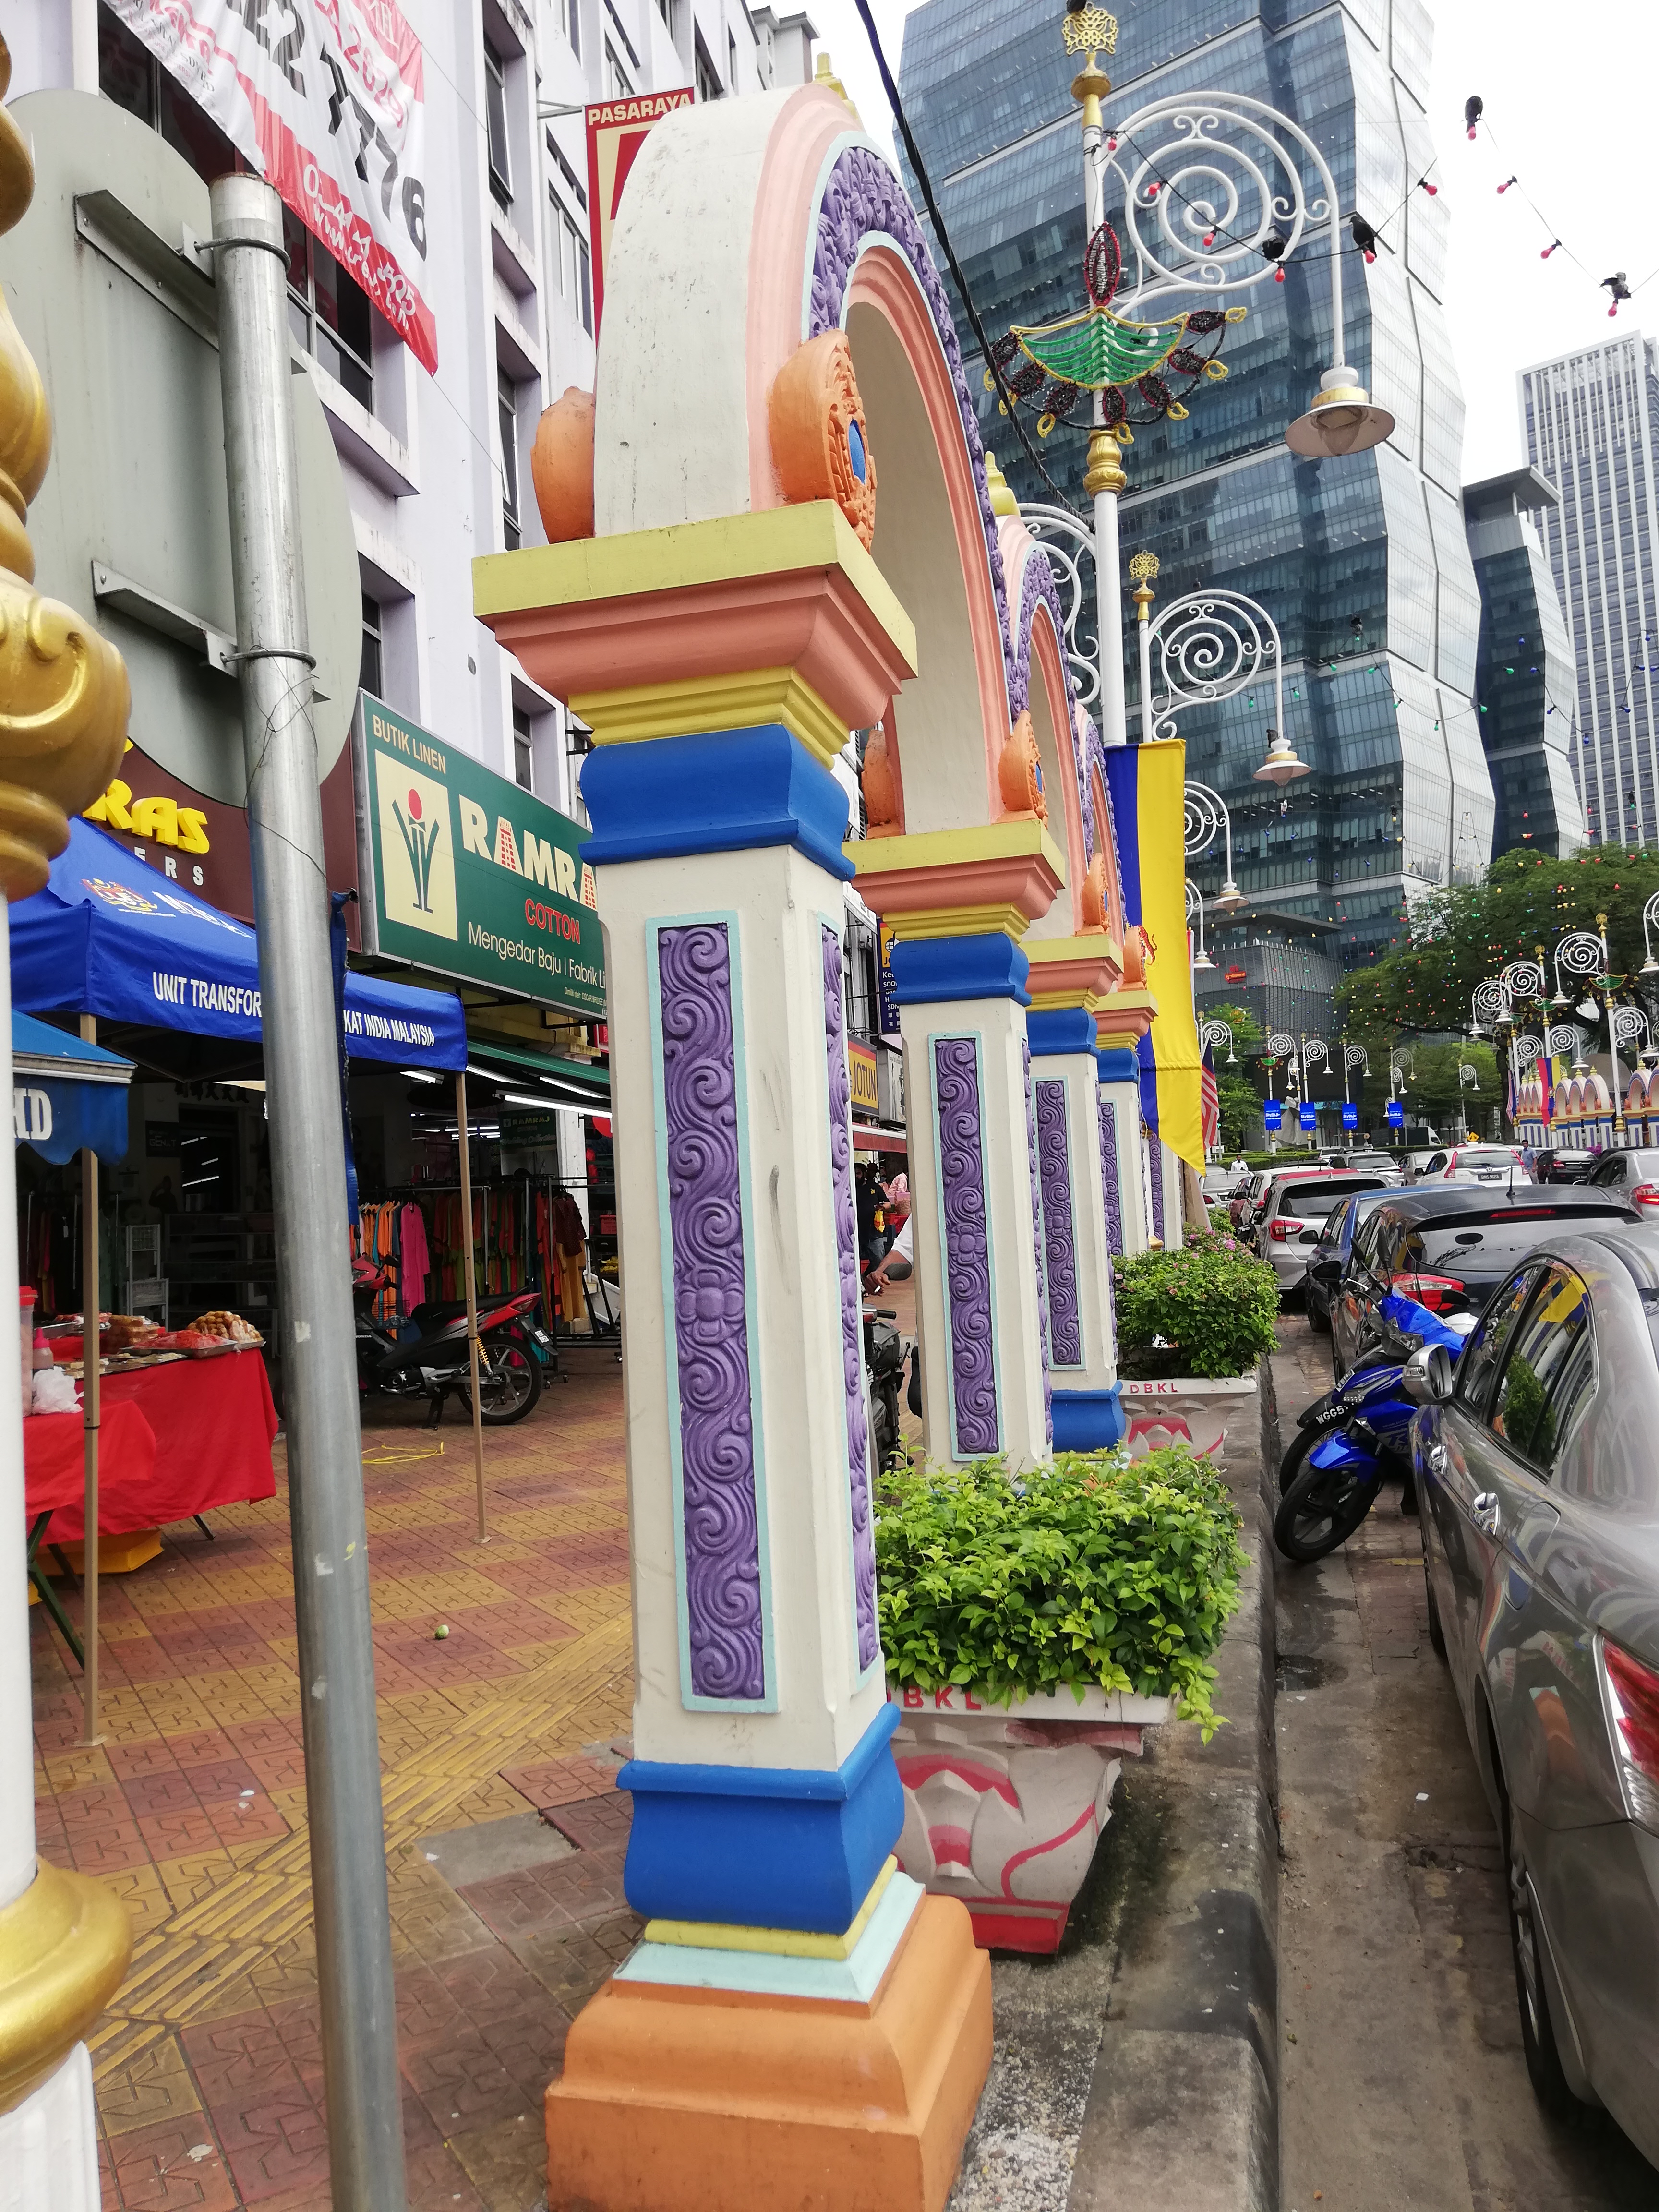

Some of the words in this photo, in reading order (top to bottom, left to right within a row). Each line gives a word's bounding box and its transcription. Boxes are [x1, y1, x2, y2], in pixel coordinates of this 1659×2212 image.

[588, 94, 691, 126] PASARAYA
[373, 714, 410, 755] BUTIK
[412, 738, 446, 774] LINEN
[525, 898, 580, 945] COTTON
[468, 921, 536, 965] Mengedar
[538, 947, 561, 976] Baju
[569, 958, 598, 986] Fabrik
[153, 972, 187, 1005] UNIT
[190, 979, 262, 1018] TRANSFOR
[364, 1013, 392, 1040] INDIA
[390, 1019, 435, 1047] MALAYSIA
[853, 1060, 877, 1101] JOTUN
[512, 1116, 550, 1125] RAMRAJ
[1129, 1382, 1179, 1394] DBKL
[1316, 1405, 1348, 1424] WGG5
